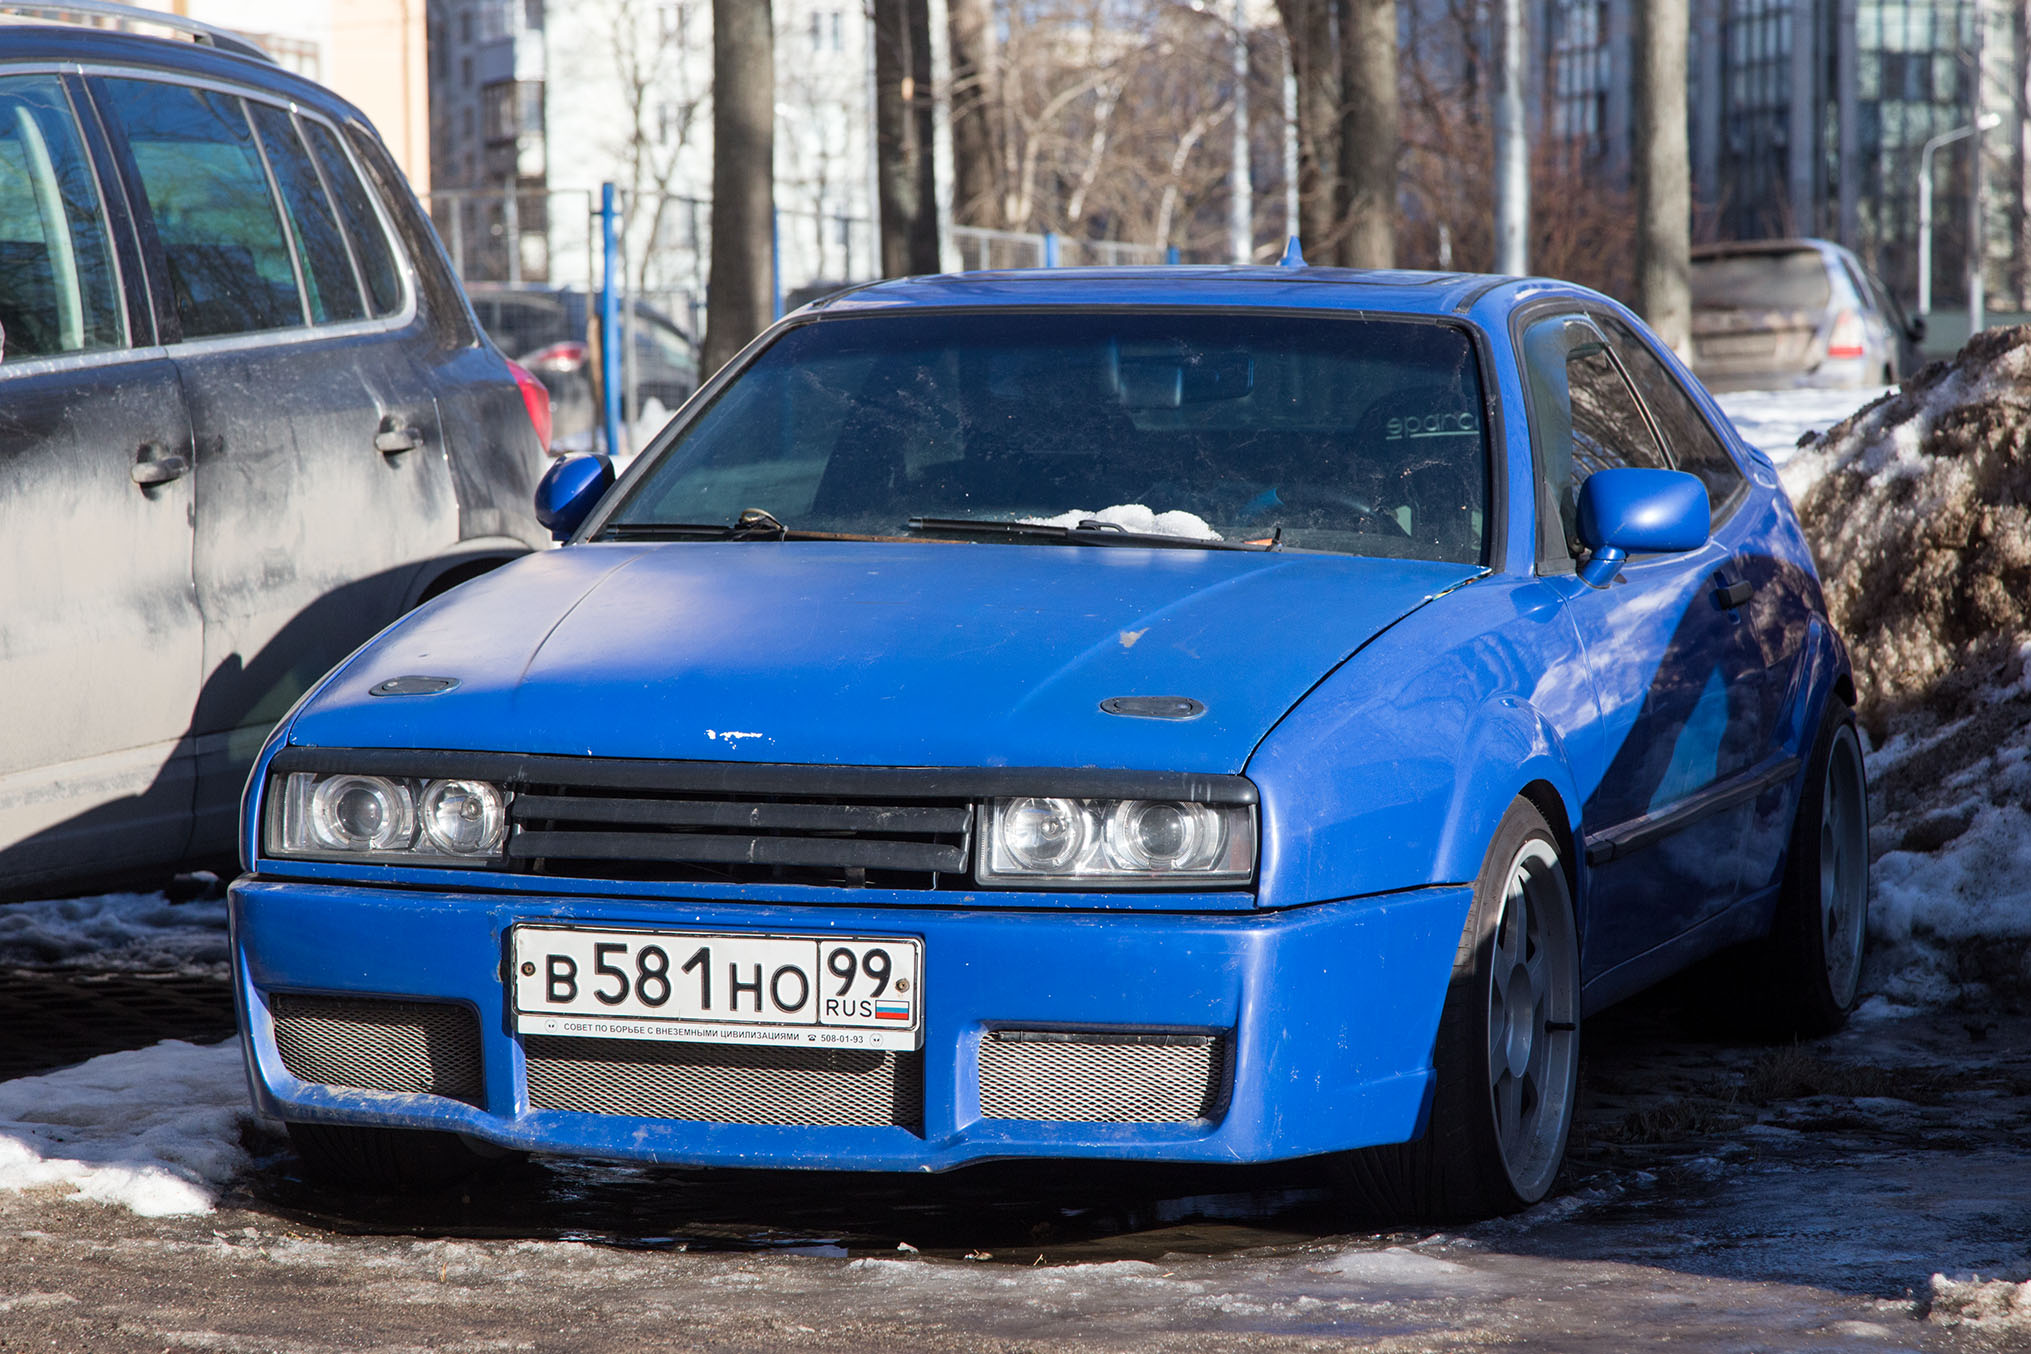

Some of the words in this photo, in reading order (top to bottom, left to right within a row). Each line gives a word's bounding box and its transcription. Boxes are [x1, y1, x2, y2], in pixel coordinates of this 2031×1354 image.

[1387, 411, 1480, 438] sparc
[827, 947, 892, 998] 99
[826, 999, 872, 1018] RUS
[563, 1022, 593, 1032] СОВЕТ
[595, 1023, 608, 1033] ПО
[609, 1024, 645, 1035] БОРЬБЕ
[647, 1026, 654, 1035] С
[655, 1027, 718, 1038] ВНЕЗЕМНЫМИ
[720, 1030, 800, 1042] ЦИВИЛИЗАЦИЯМИ
[820, 1034, 864, 1044] 508-01-93
